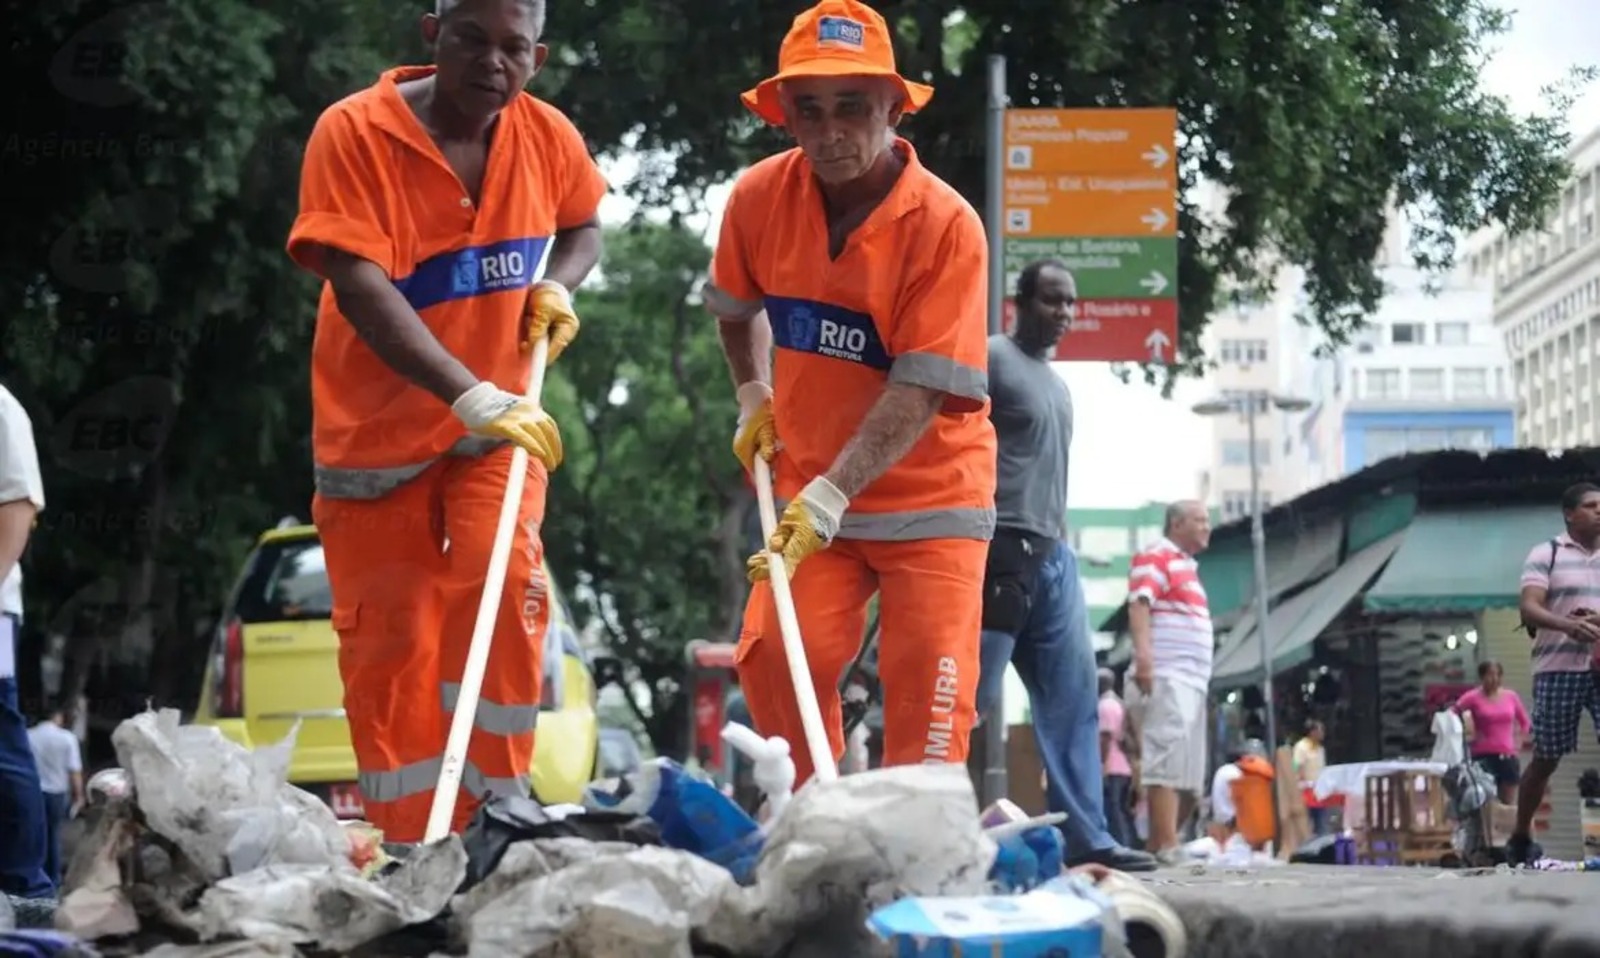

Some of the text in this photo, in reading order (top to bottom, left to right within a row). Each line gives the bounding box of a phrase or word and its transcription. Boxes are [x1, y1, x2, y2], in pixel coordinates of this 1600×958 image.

[841, 25, 861, 39] RIO
[481, 251, 524, 281] RIO
[820, 319, 866, 352] RIO
